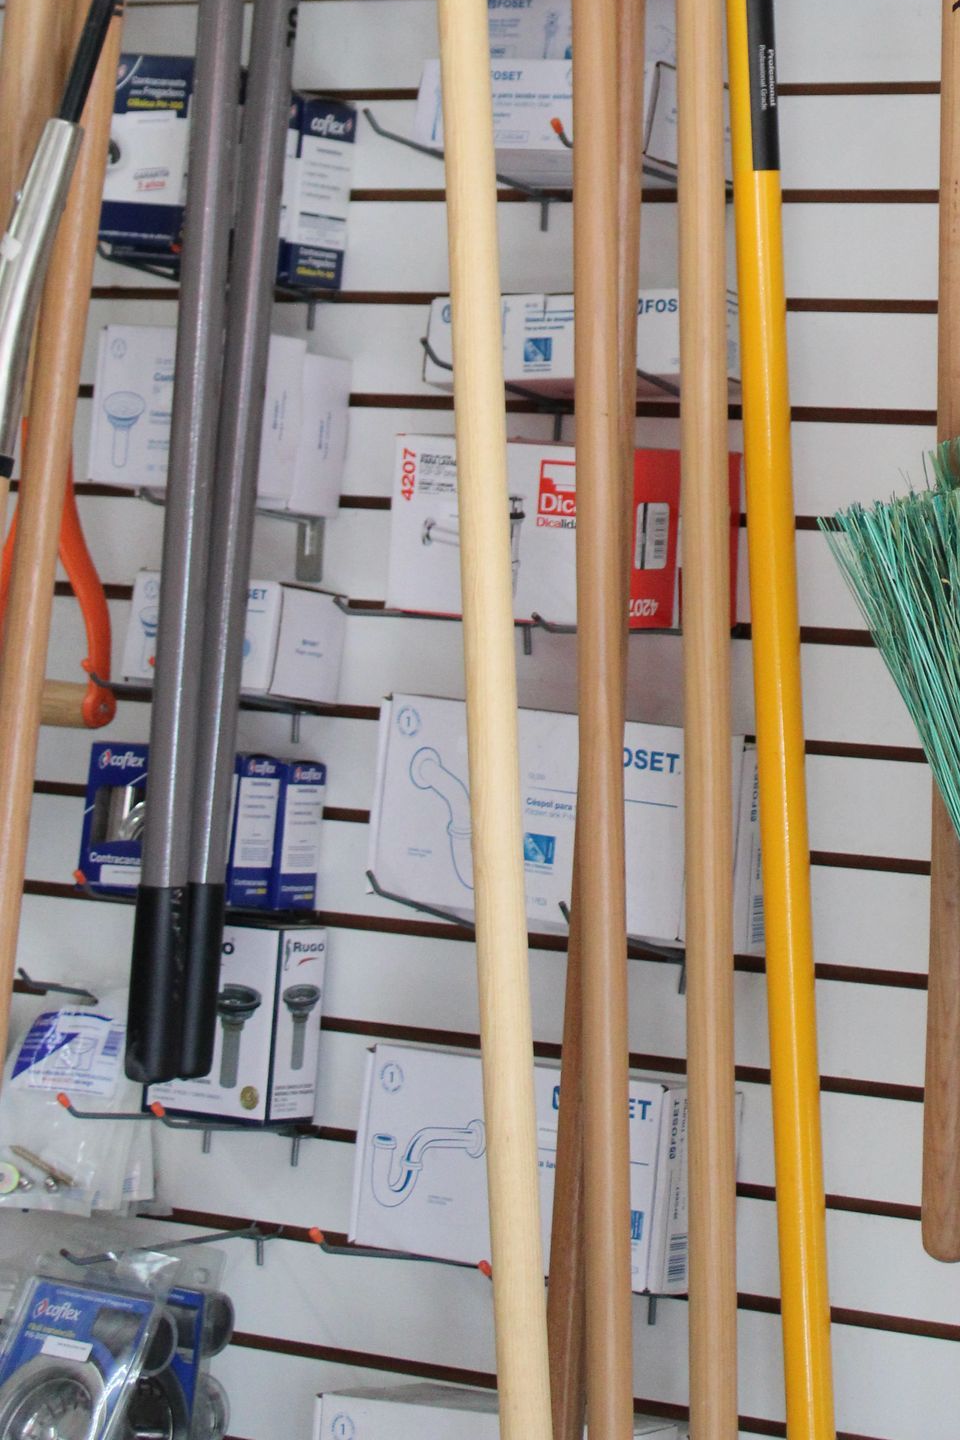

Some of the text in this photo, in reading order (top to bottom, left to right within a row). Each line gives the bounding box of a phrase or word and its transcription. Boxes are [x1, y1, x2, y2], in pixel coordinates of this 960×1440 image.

[492, 71, 523, 81] OSET
[311, 114, 346, 136] coflex
[645, 298, 678, 313] FOS
[401, 447, 417, 501] 4207
[541, 493, 576, 513] Dic
[112, 751, 144, 769] coflex
[624, 747, 680, 774] OSET
[670, 1098, 680, 1146] FOSET
[46, 1302, 82, 1322] coflex
